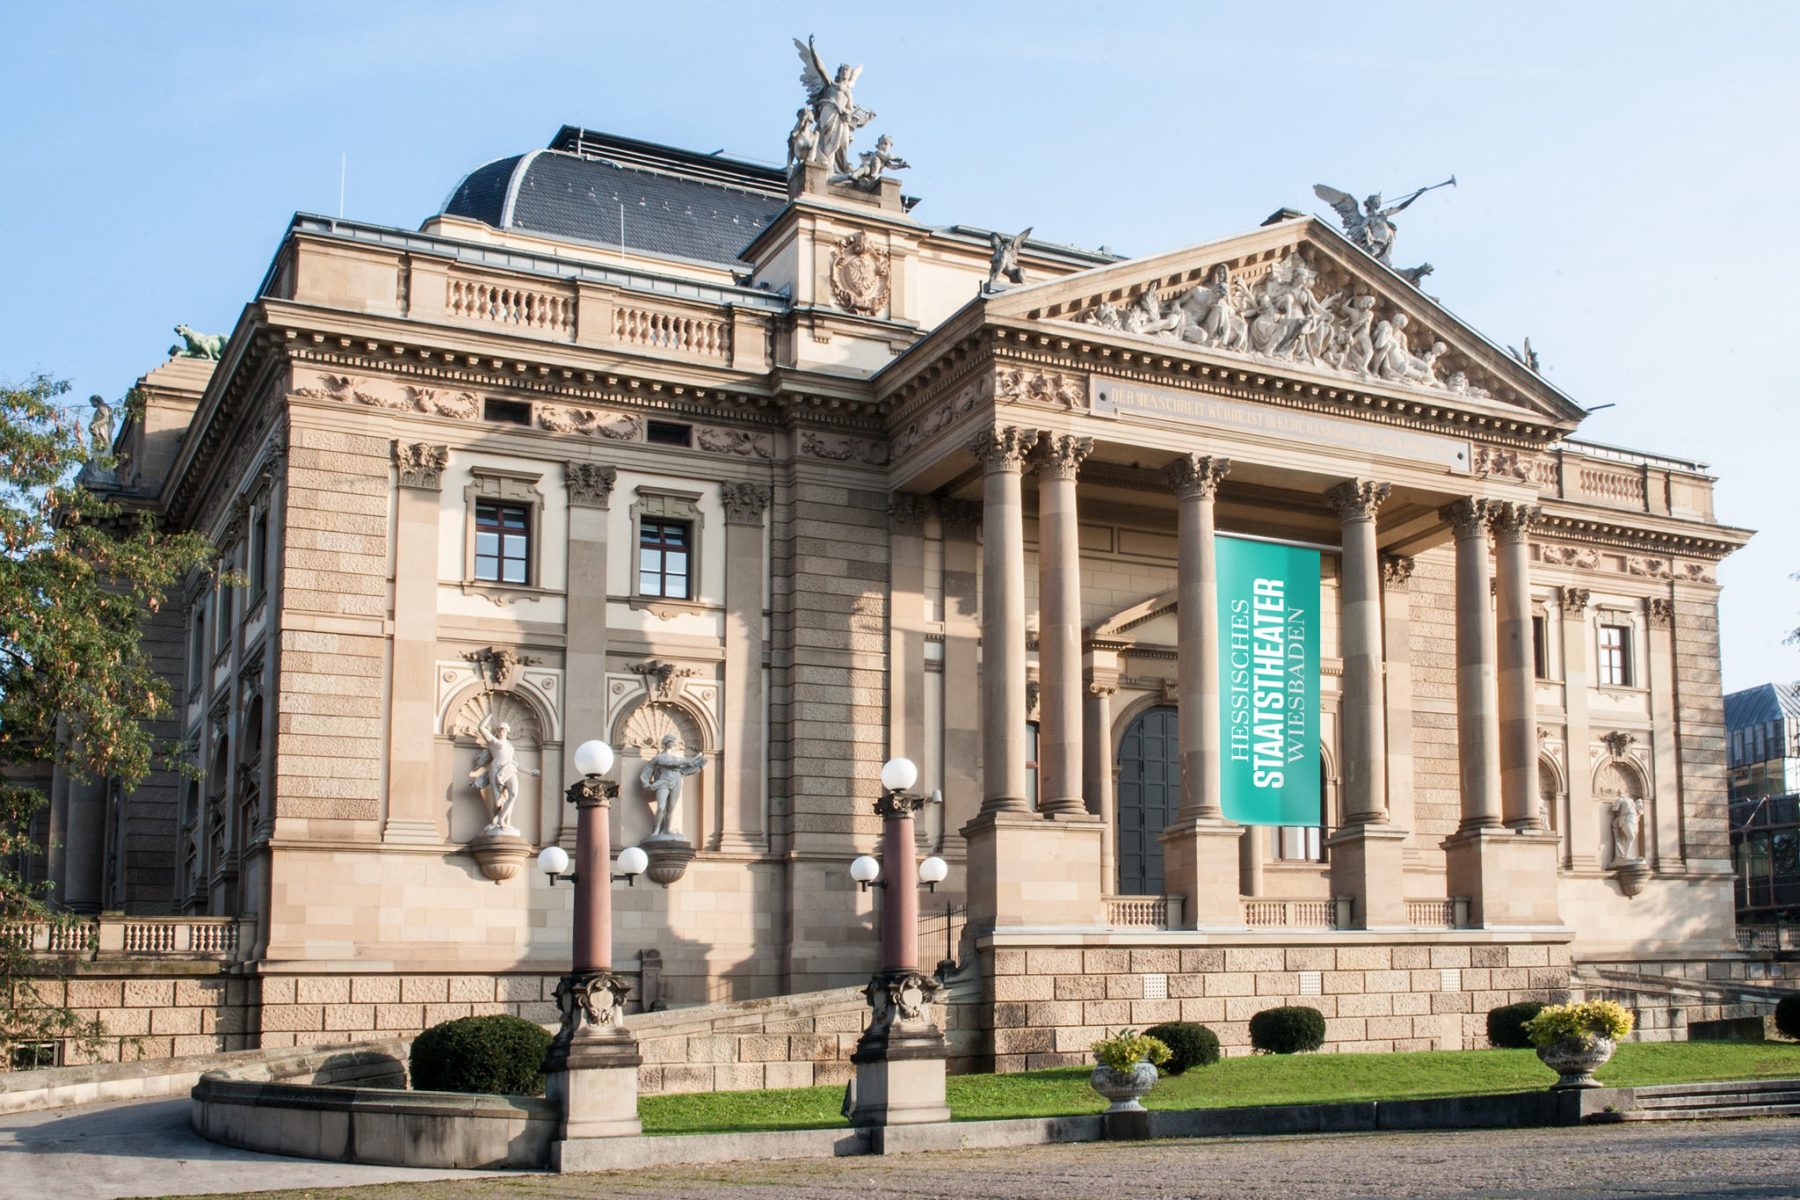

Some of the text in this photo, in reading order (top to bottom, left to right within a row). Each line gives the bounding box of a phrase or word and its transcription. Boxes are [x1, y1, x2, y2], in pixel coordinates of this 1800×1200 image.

[1111, 387, 1134, 405] DER
[1136, 391, 1204, 416] MENSCHHEIT
[1246, 410, 1263, 426] IST
[1231, 599, 1250, 763] HESSISCHES
[1252, 577, 1285, 789] STAATSTHEATER
[1287, 606, 1305, 764] WIESBADEN
